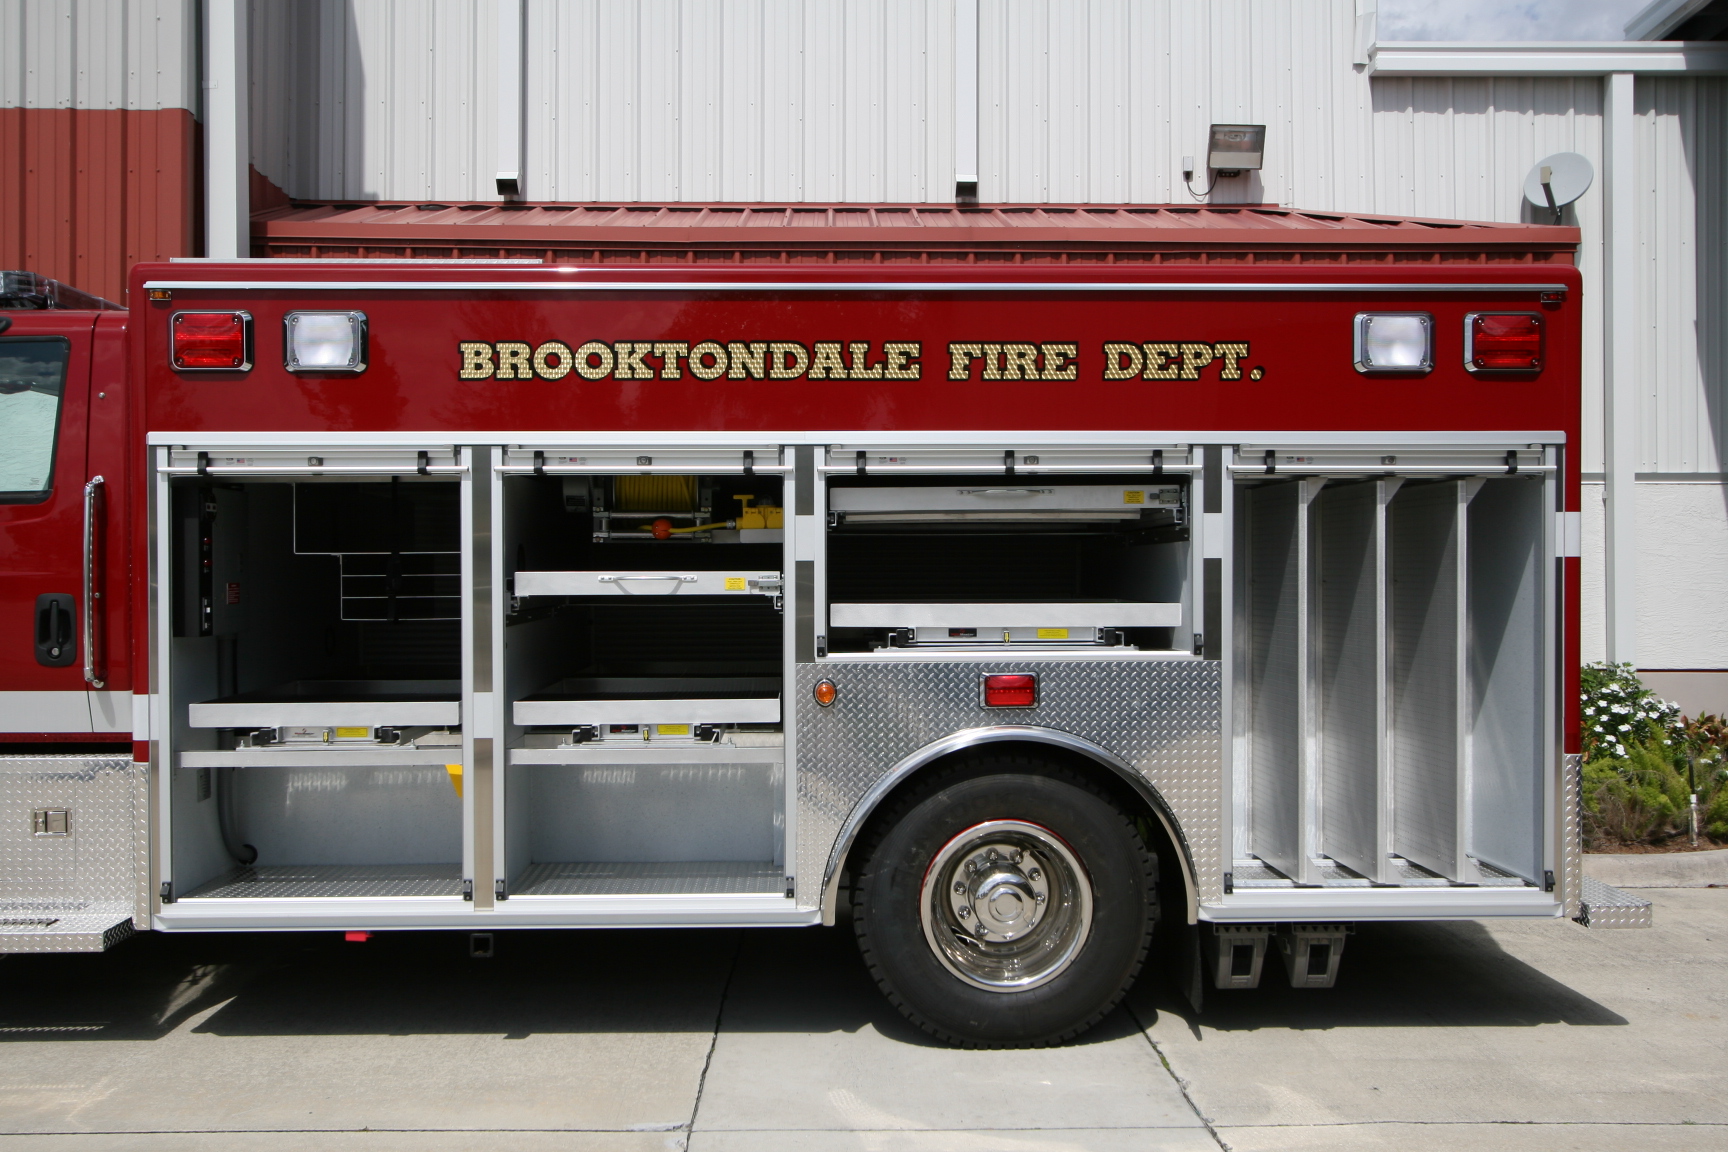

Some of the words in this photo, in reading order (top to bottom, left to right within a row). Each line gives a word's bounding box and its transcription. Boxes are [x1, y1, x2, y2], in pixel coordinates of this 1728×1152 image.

[459, 341, 921, 380] BROOKTONDALE
[949, 343, 1077, 381] FIRE
[1104, 343, 1264, 381] DEPT.
